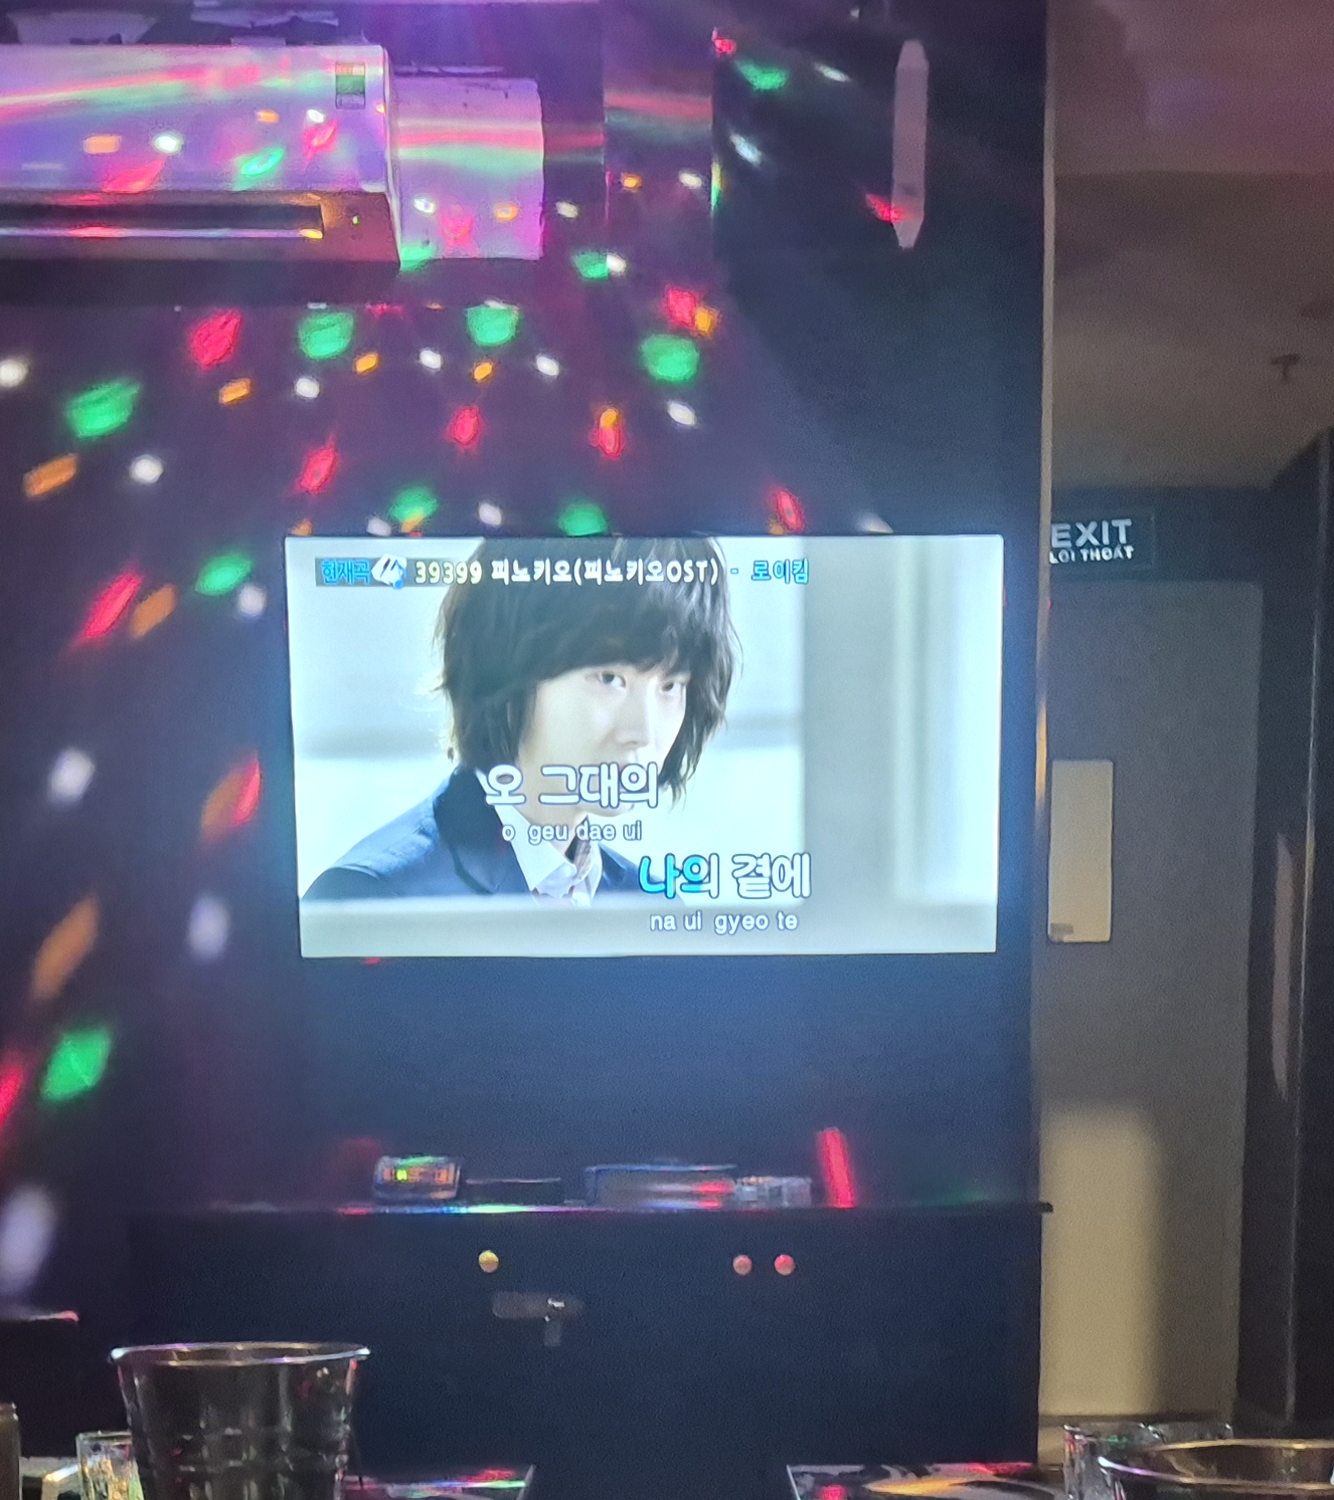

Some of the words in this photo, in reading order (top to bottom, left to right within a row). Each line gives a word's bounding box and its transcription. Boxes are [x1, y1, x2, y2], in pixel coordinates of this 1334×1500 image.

[1051, 518, 1133, 548] EXIT
[321, 558, 371, 585] 현재곡
[415, 560, 483, 586] 39399
[750, 558, 810, 585] 로이킴
[485, 763, 526, 806] 오
[537, 761, 659, 809] 그대의
[501, 824, 516, 842] o
[527, 822, 568, 845] geu
[575, 820, 616, 842] dae
[622, 820, 643, 842] ui
[638, 852, 720, 899] 나의
[731, 852, 811, 899] 곁에
[649, 912, 677, 932] na
[683, 910, 703, 931] ui
[713, 912, 770, 935] gyeo
[776, 911, 799, 931] te
